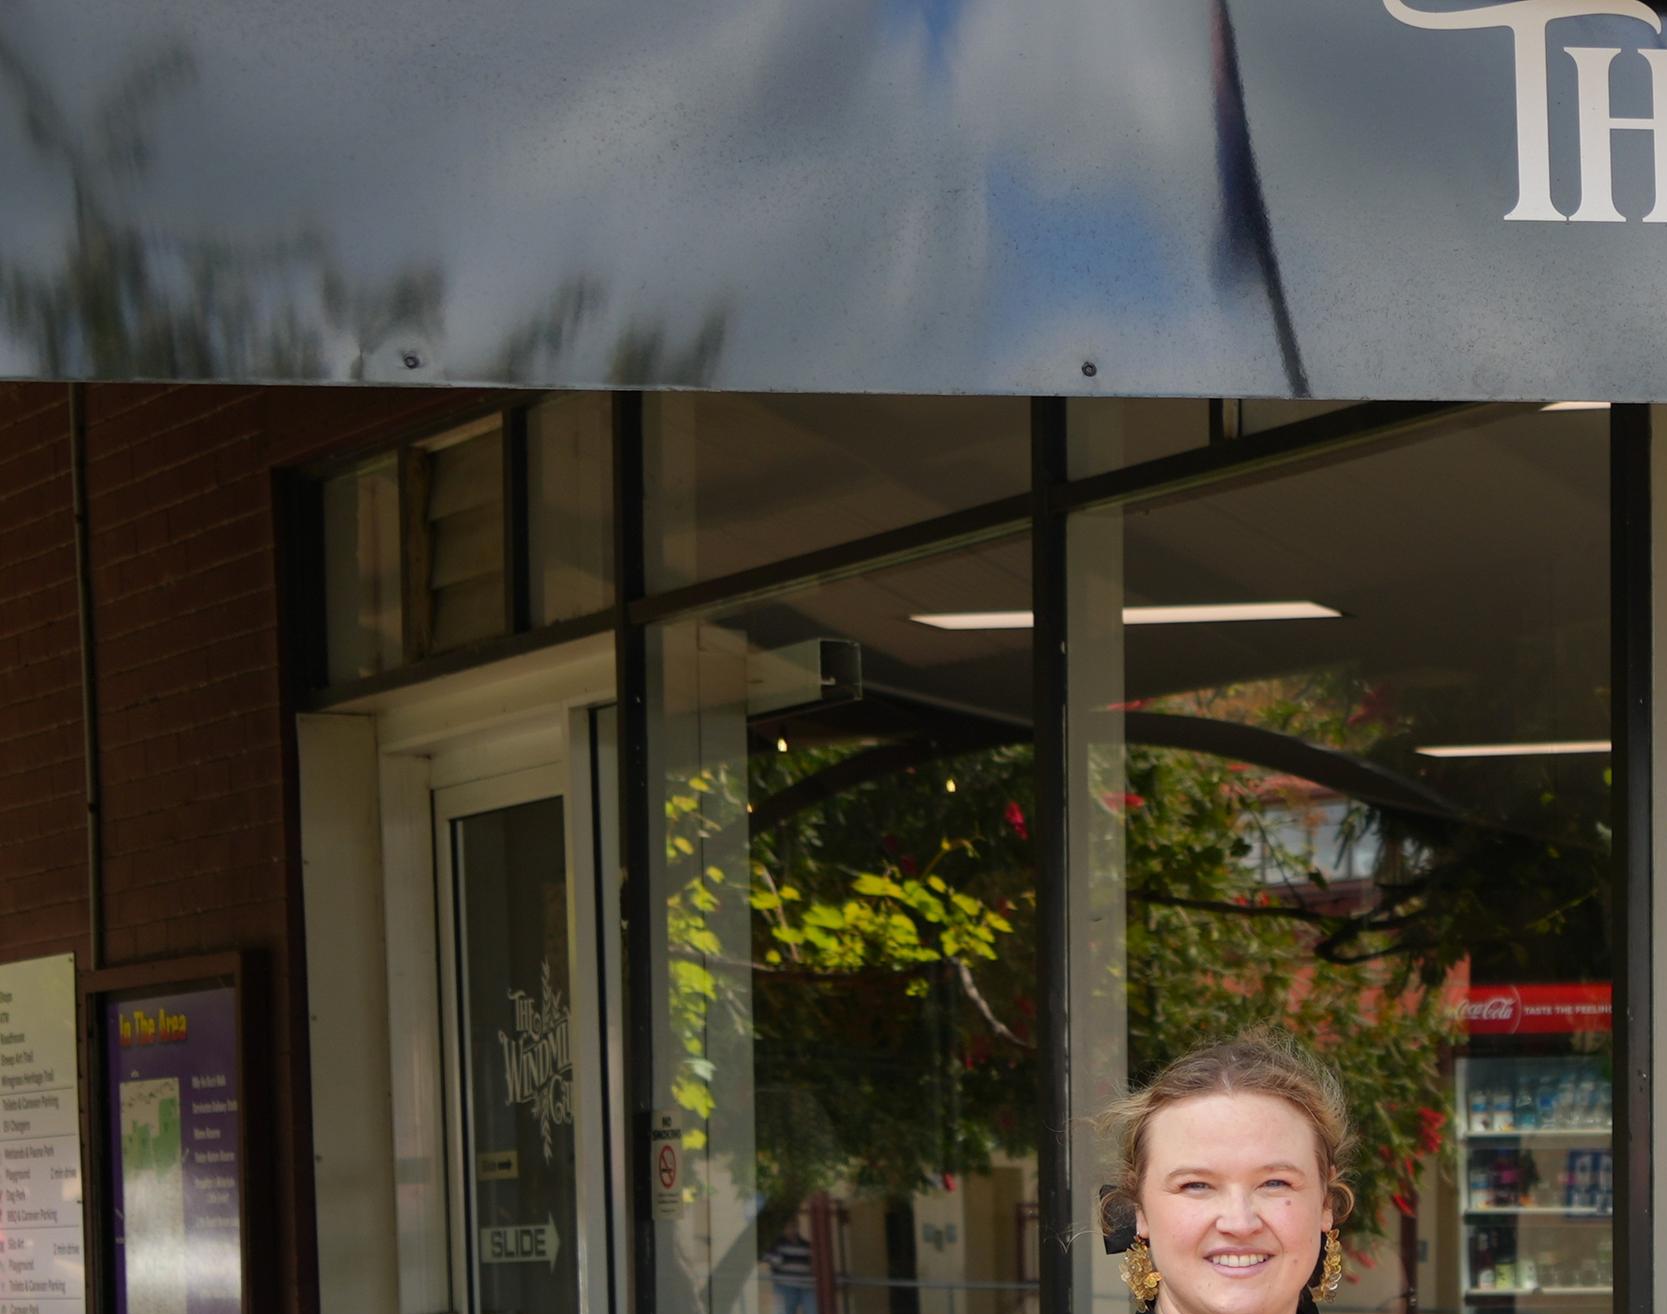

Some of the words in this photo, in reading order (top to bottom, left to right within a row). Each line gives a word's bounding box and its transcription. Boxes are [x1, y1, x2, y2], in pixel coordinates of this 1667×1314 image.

[507, 988, 542, 1041] THE
[1524, 1006, 1552, 1016] TASTE
[1556, 1005, 1572, 1015] THE
[119, 1013, 133, 1048] In
[134, 1010, 157, 1047] The
[158, 1008, 188, 1041] Area
[491, 1229, 546, 1258] SLIDE
